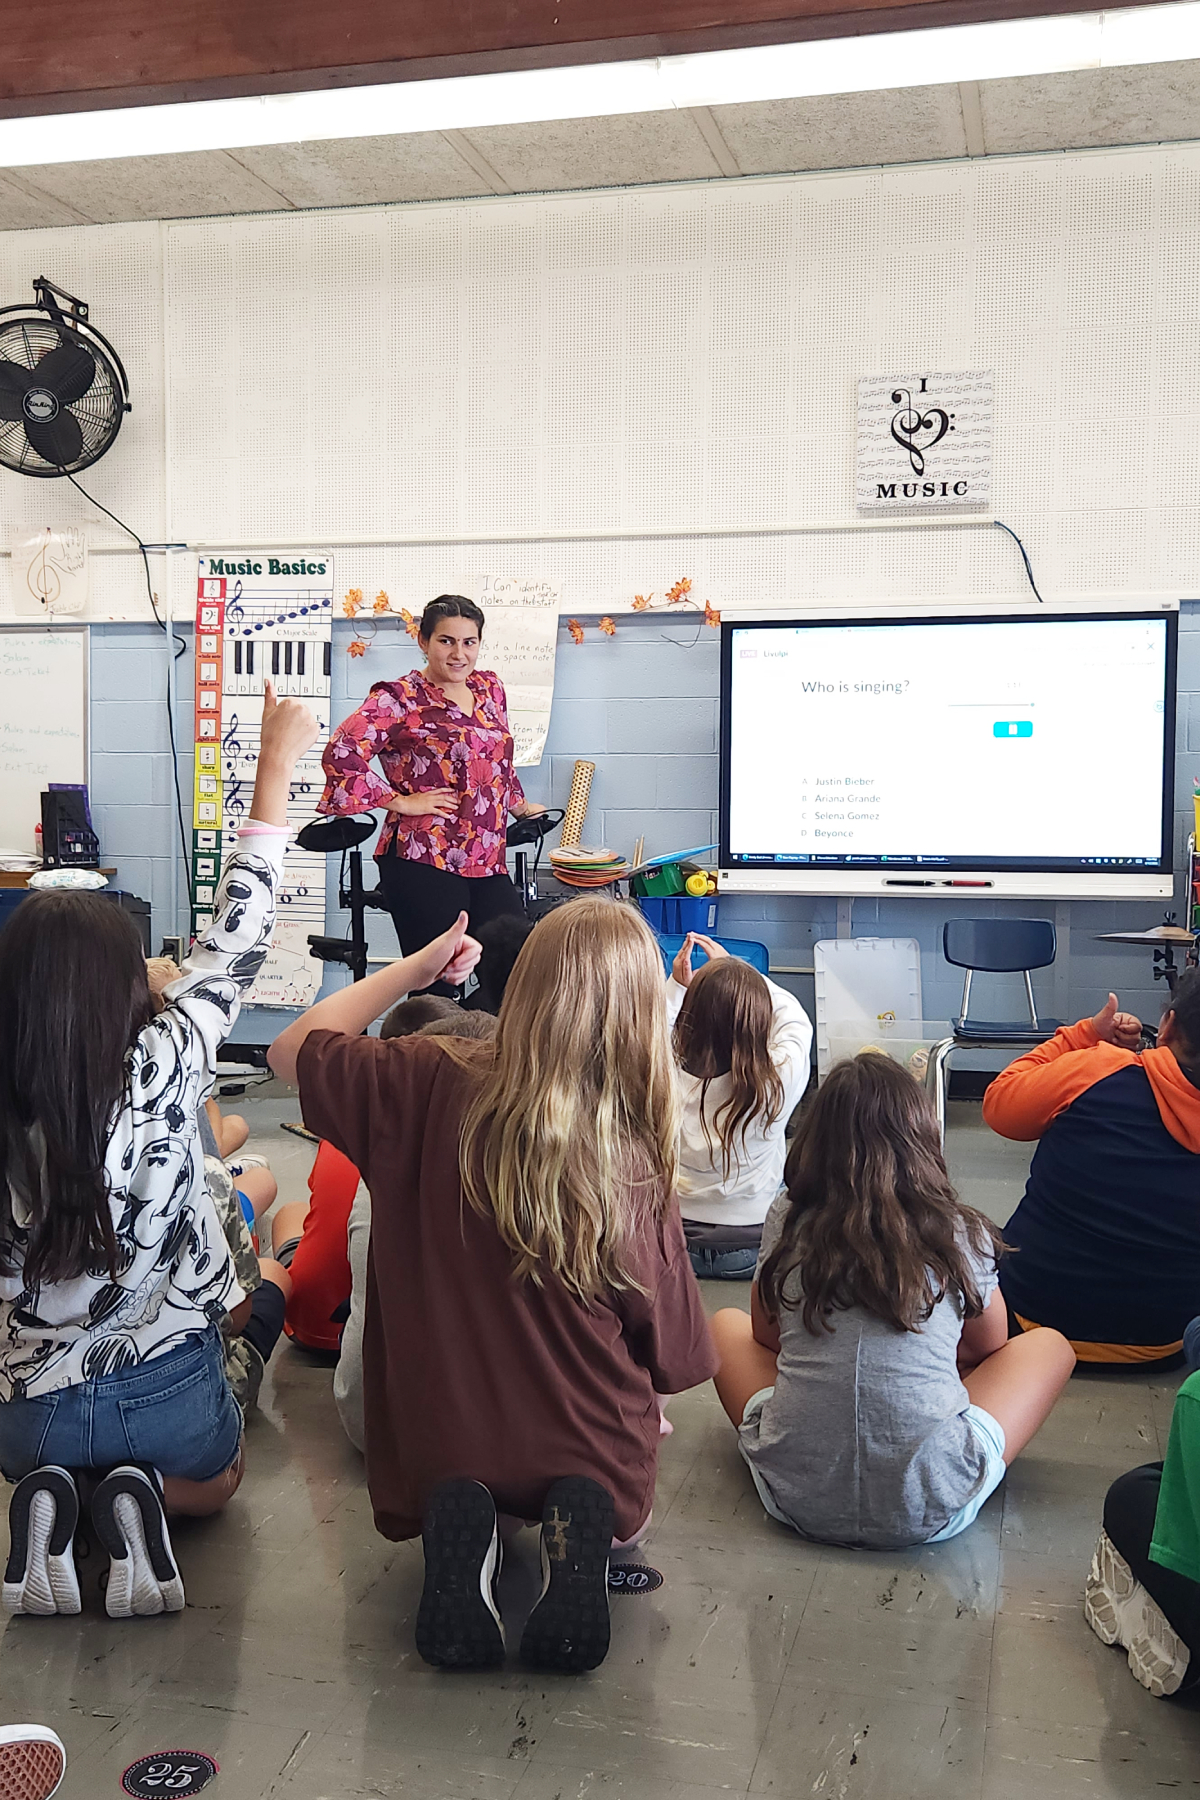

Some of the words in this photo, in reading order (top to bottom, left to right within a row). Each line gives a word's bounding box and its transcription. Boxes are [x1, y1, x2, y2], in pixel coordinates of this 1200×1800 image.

[919, 377, 928, 393] I
[876, 480, 969, 499] MUSIC
[209, 558, 263, 576] Music
[267, 558, 327, 576] Basics
[482, 575, 491, 591] I
[515, 642, 531, 652] line
[535, 641, 554, 654] note
[504, 655, 527, 664] space
[801, 681, 835, 693] Who
[839, 680, 849, 693] is
[853, 679, 910, 695] singing?
[815, 777, 842, 786] Justin
[844, 777, 875, 786] Bieber
[815, 794, 845, 803] Ariana
[847, 794, 881, 803] Grande
[815, 811, 845, 820] Selena
[847, 811, 880, 821] Gomez
[814, 828, 854, 839] Beyonce
[138, 1762, 201, 1789] 25
